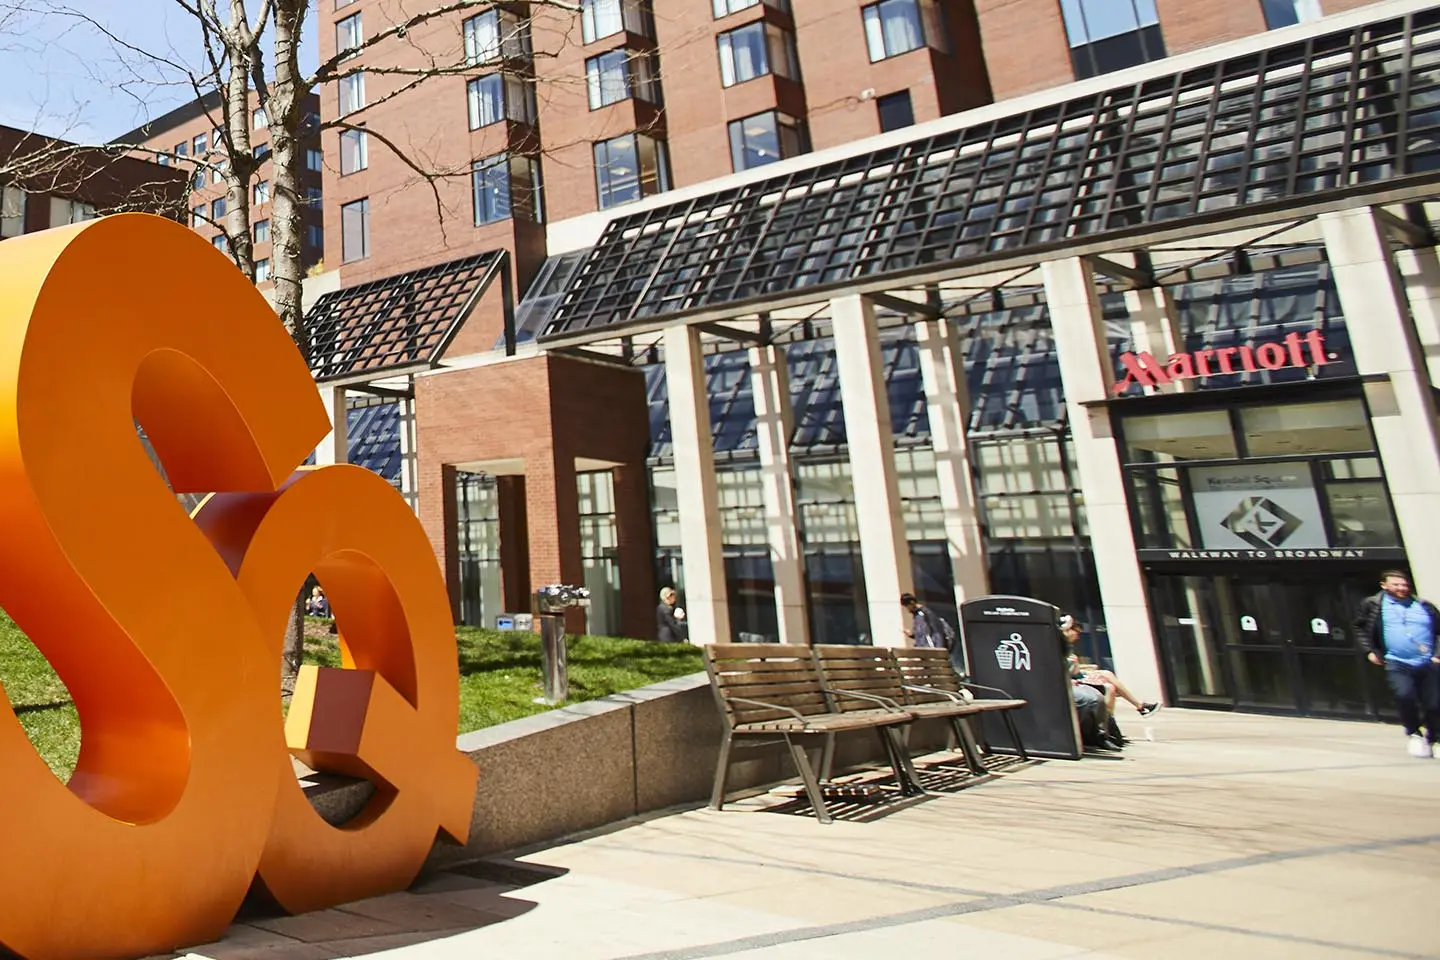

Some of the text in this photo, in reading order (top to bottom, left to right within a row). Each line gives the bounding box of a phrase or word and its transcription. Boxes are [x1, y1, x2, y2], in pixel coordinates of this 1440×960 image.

[1112, 329, 1326, 394] Marriott
[1168, 550, 1365, 558] WALKWAY TO BROADWAY
